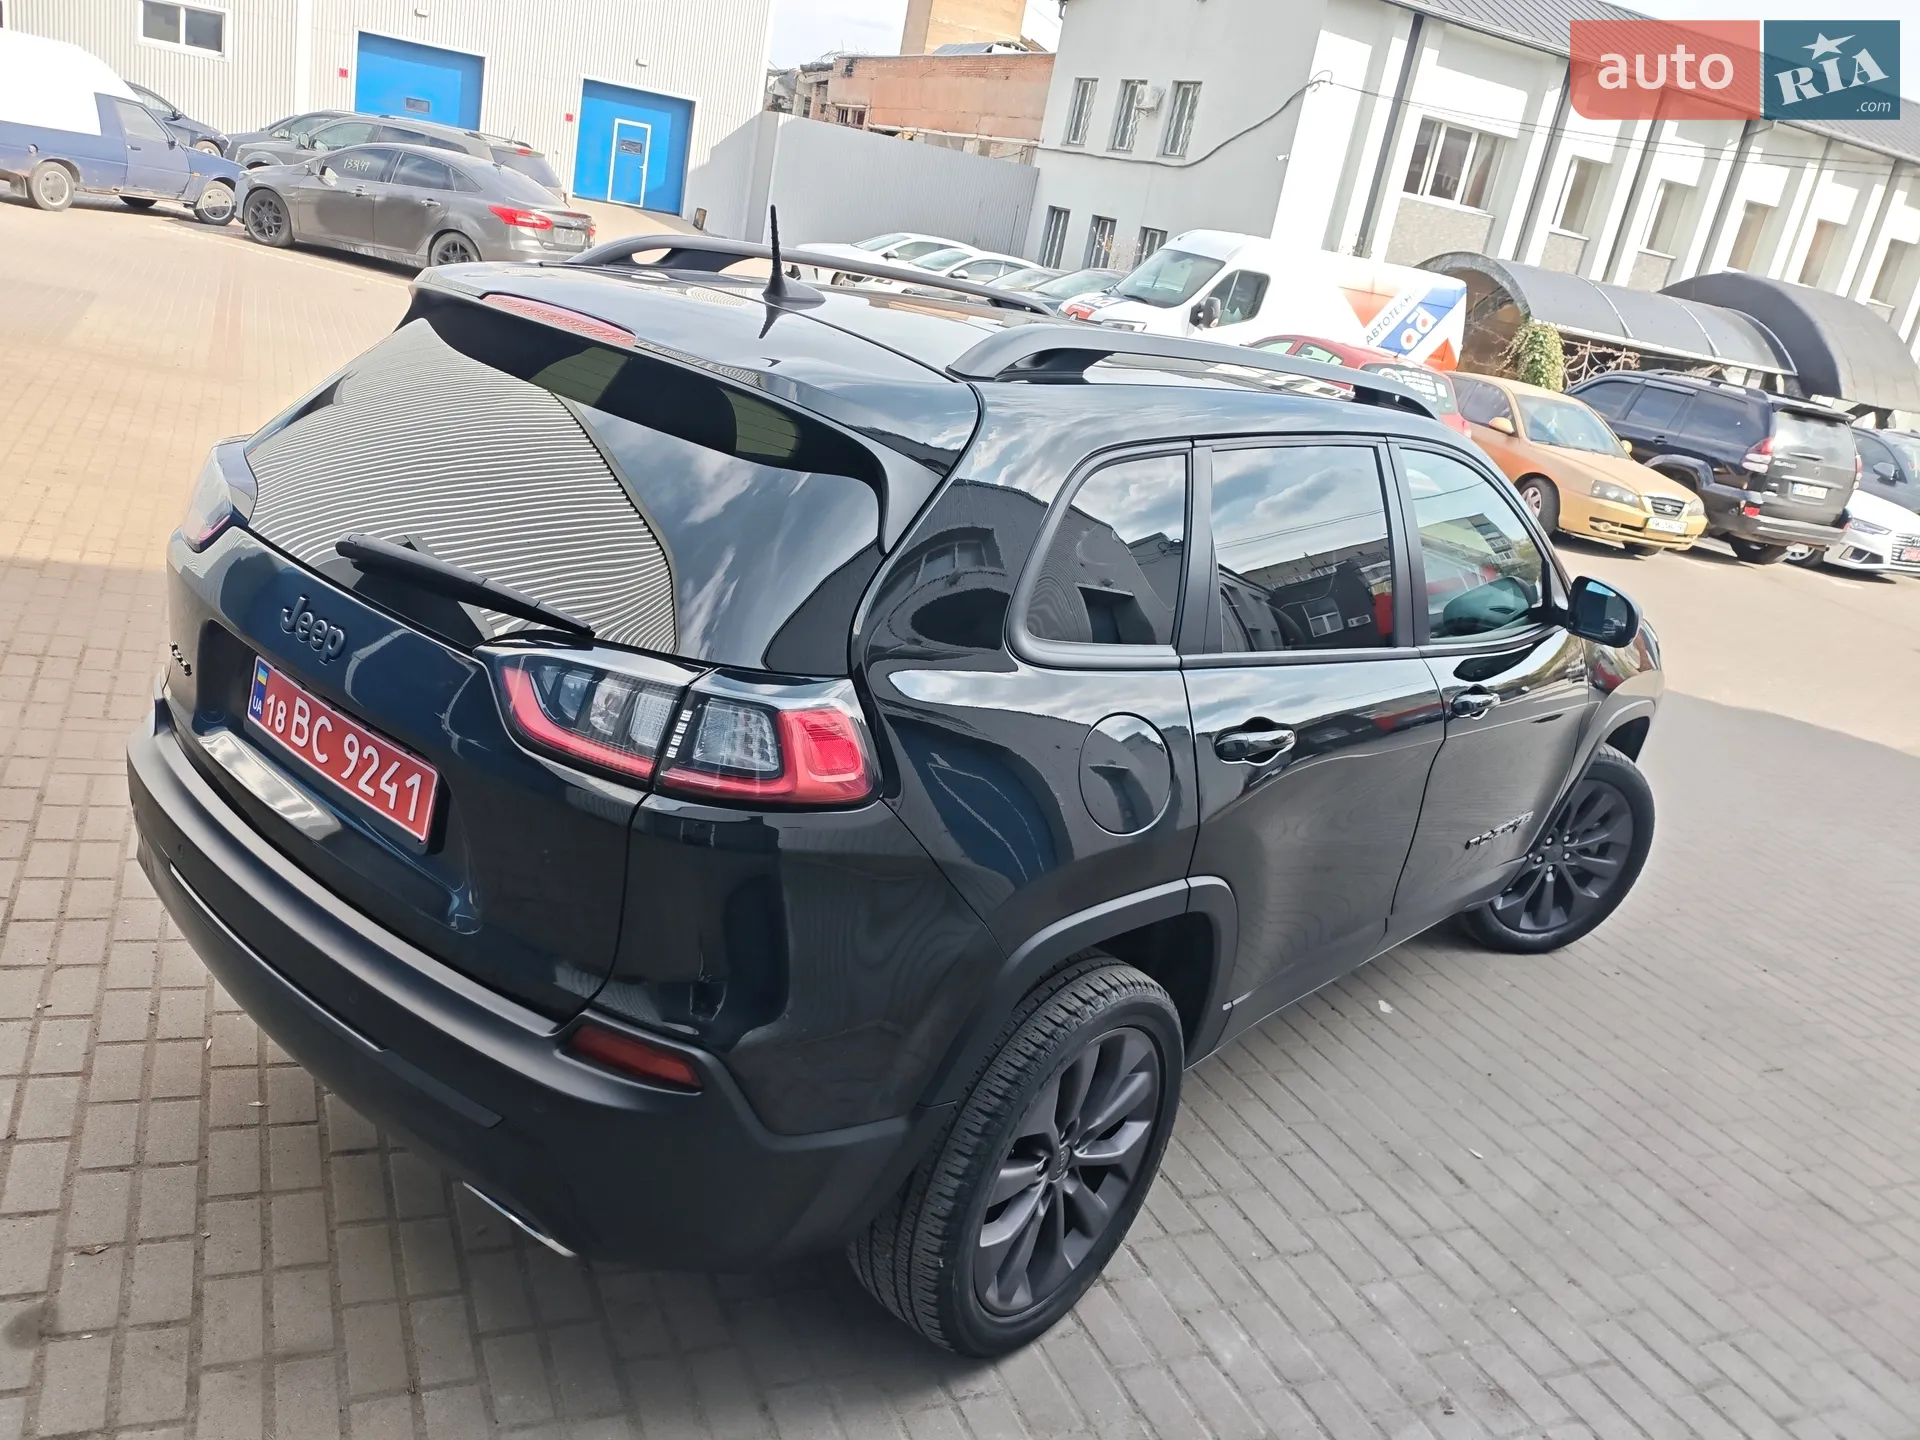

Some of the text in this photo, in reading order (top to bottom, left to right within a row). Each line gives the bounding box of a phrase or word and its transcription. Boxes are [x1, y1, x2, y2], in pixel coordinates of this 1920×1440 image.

[280, 594, 347, 664] Jeep
[252, 695, 263, 715] UA
[266, 693, 422, 823] 18 BC 9241
